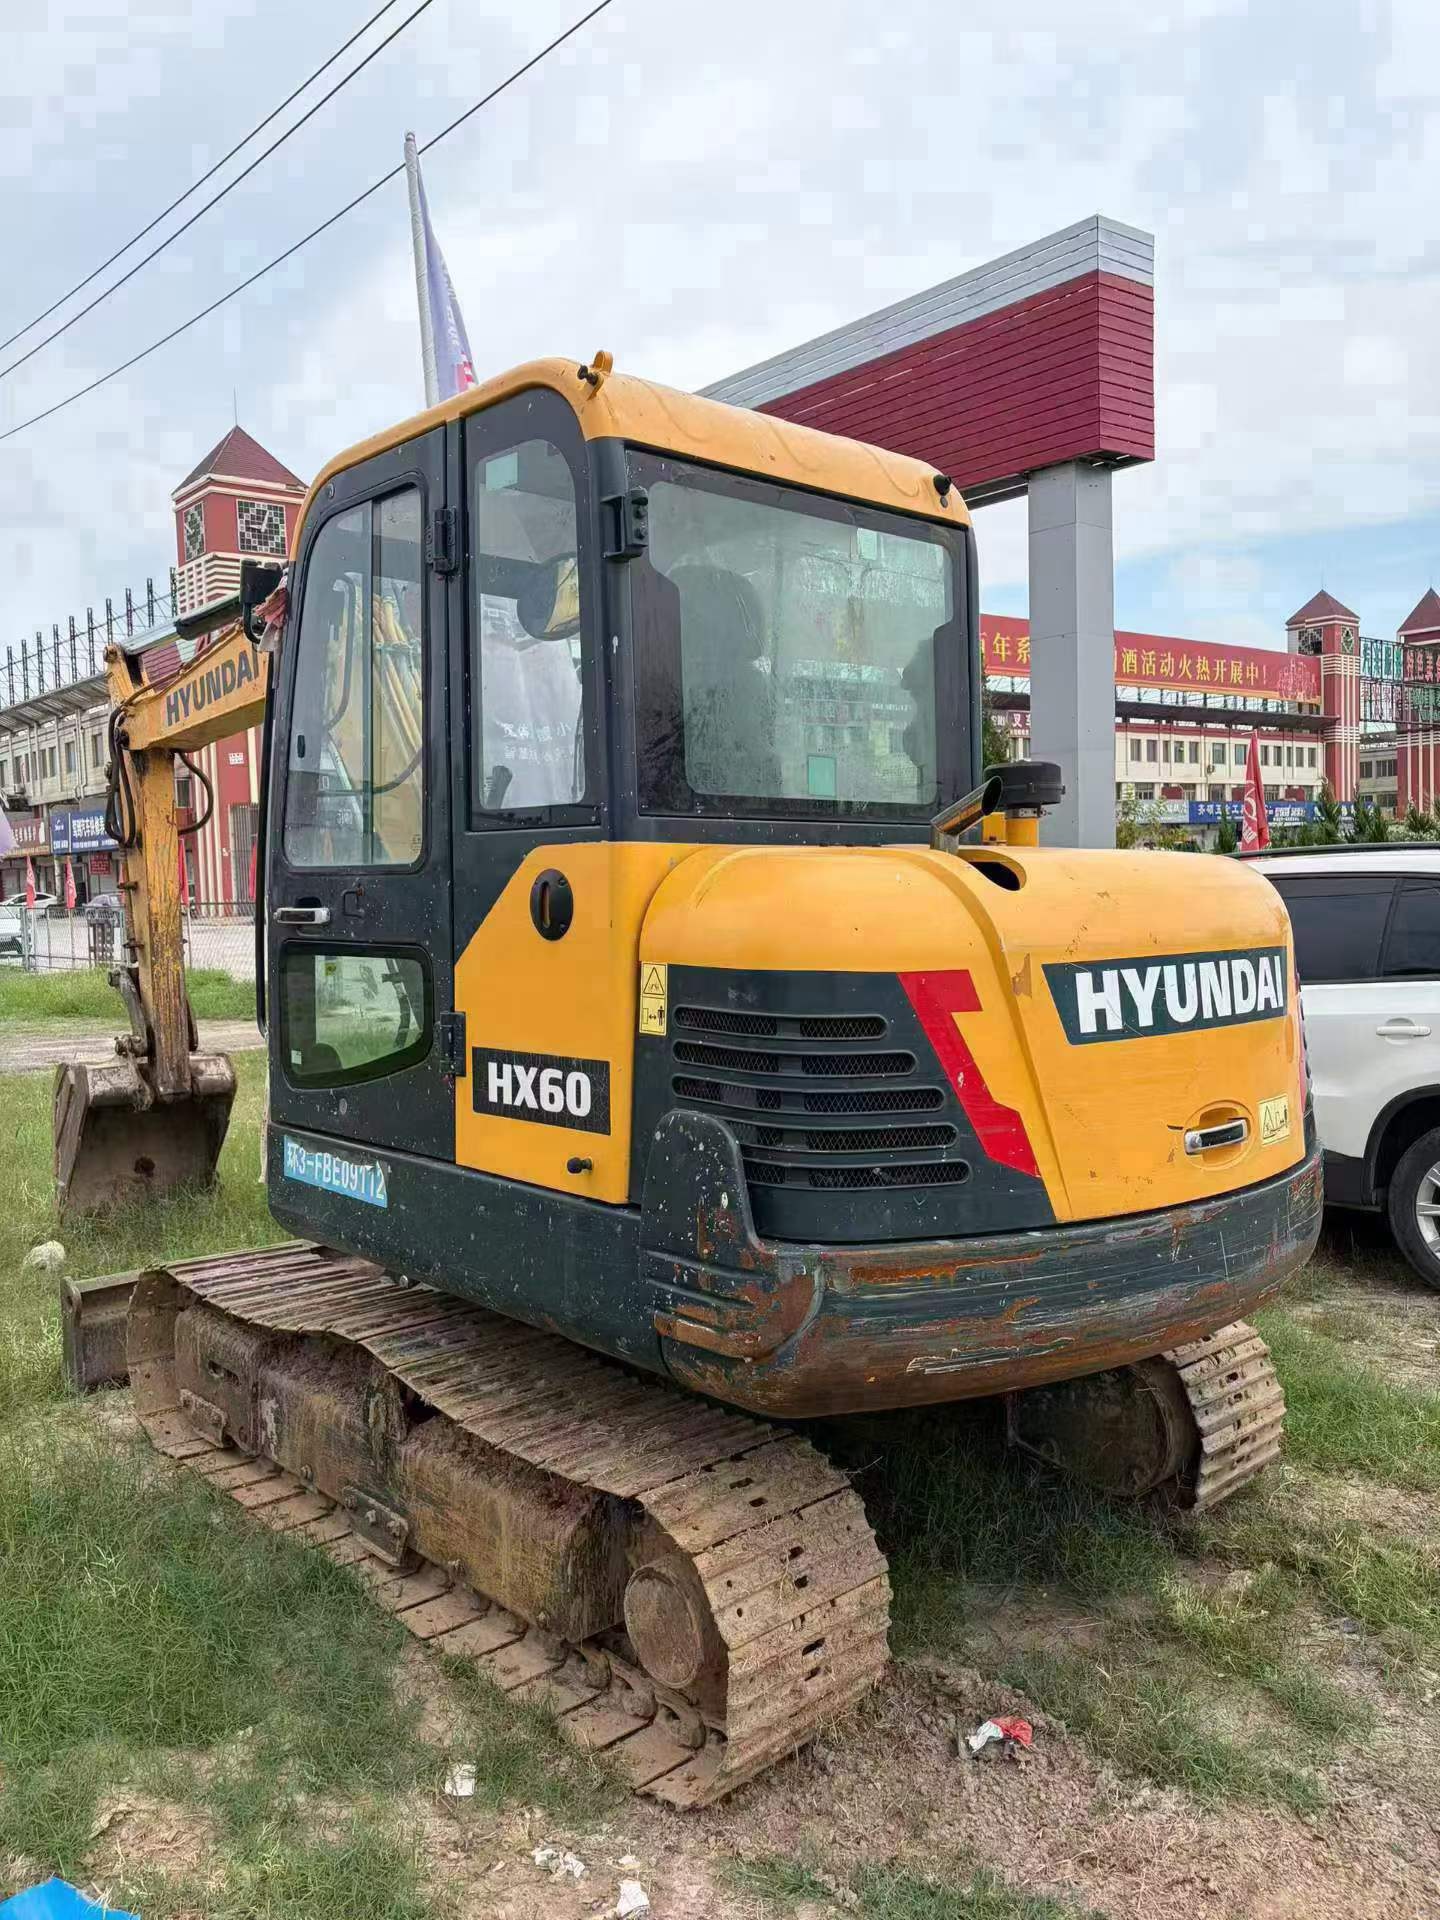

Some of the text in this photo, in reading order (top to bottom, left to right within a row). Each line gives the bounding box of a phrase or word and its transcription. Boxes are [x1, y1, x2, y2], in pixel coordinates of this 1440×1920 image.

[166, 647, 259, 727] HYUNDAI
[1114, 647, 1267, 686] 酒活动火热开展中！
[1075, 955, 1284, 1034] HYUNDAI
[487, 1061, 592, 1118] HX60
